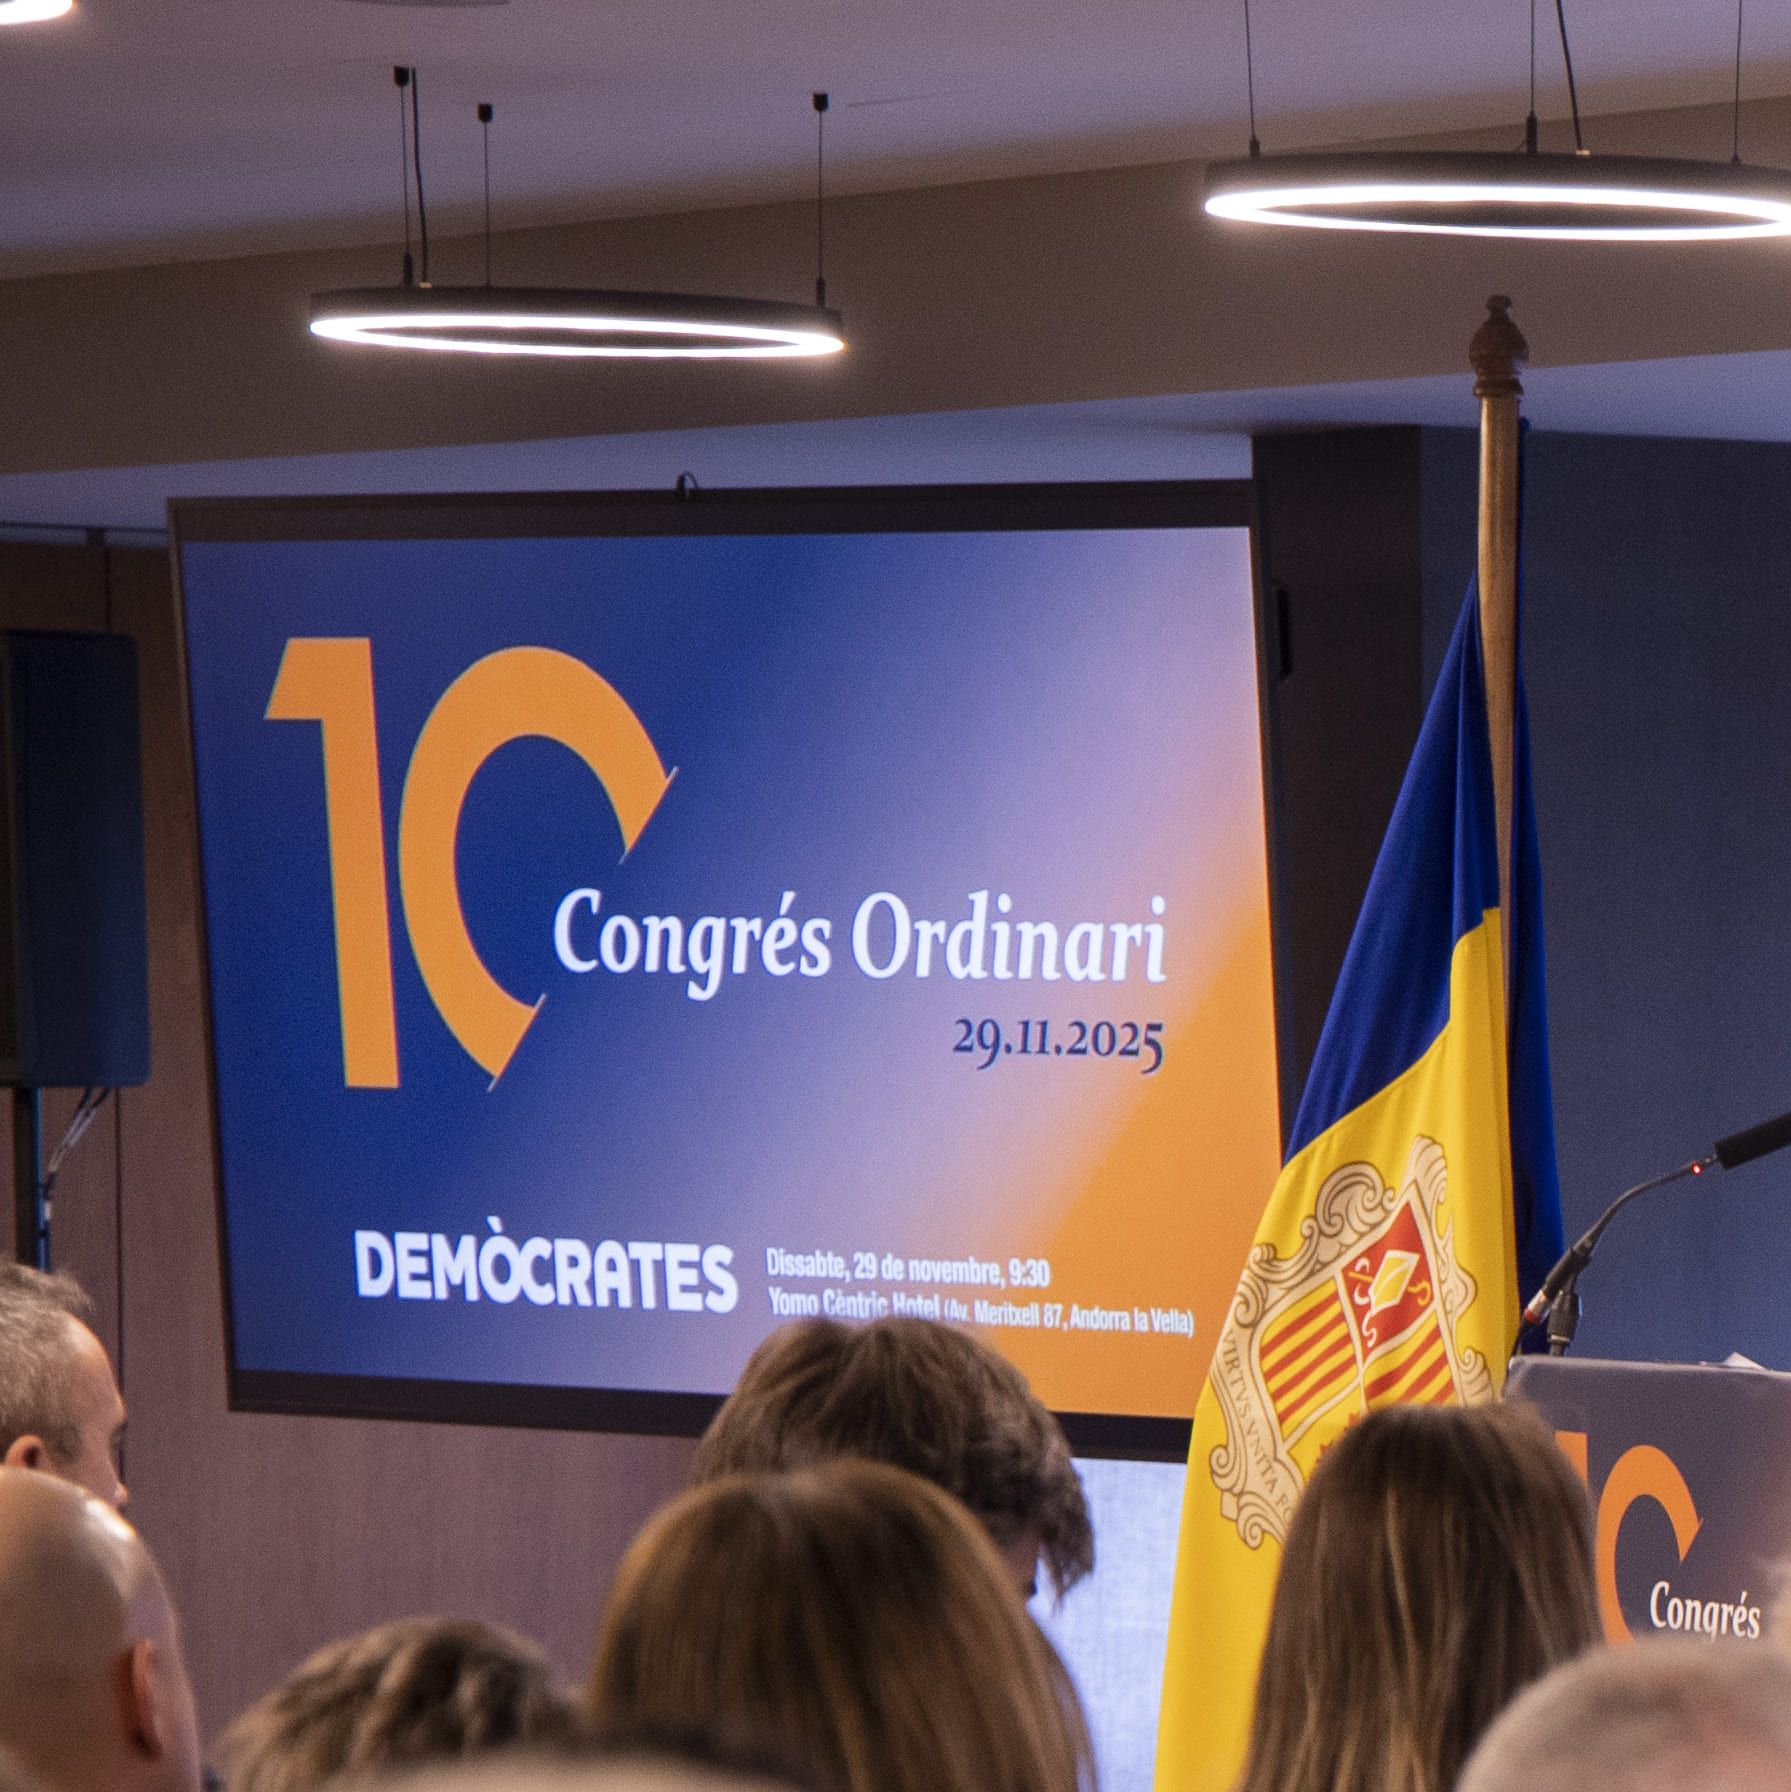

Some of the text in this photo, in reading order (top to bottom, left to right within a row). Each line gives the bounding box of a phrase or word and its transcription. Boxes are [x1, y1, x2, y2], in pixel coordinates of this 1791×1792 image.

[553, 887, 1167, 1001] Congrés Ordinari
[952, 1018, 1165, 1074] 29.11.2025
[353, 1215, 739, 1314] DEMÒCRATES
[766, 1247, 1050, 1290] Dissabte, 29 de novembre, 9:30
[768, 1286, 819, 1316] Yomo
[892, 1291, 940, 1320] Hotel
[974, 1300, 1040, 1327] Meritxell
[1069, 1304, 1130, 1331] Andorra
[1134, 1307, 1148, 1332] la
[1151, 1308, 1194, 1338] Vella)
[1650, 1581, 1761, 1643] Congrés
